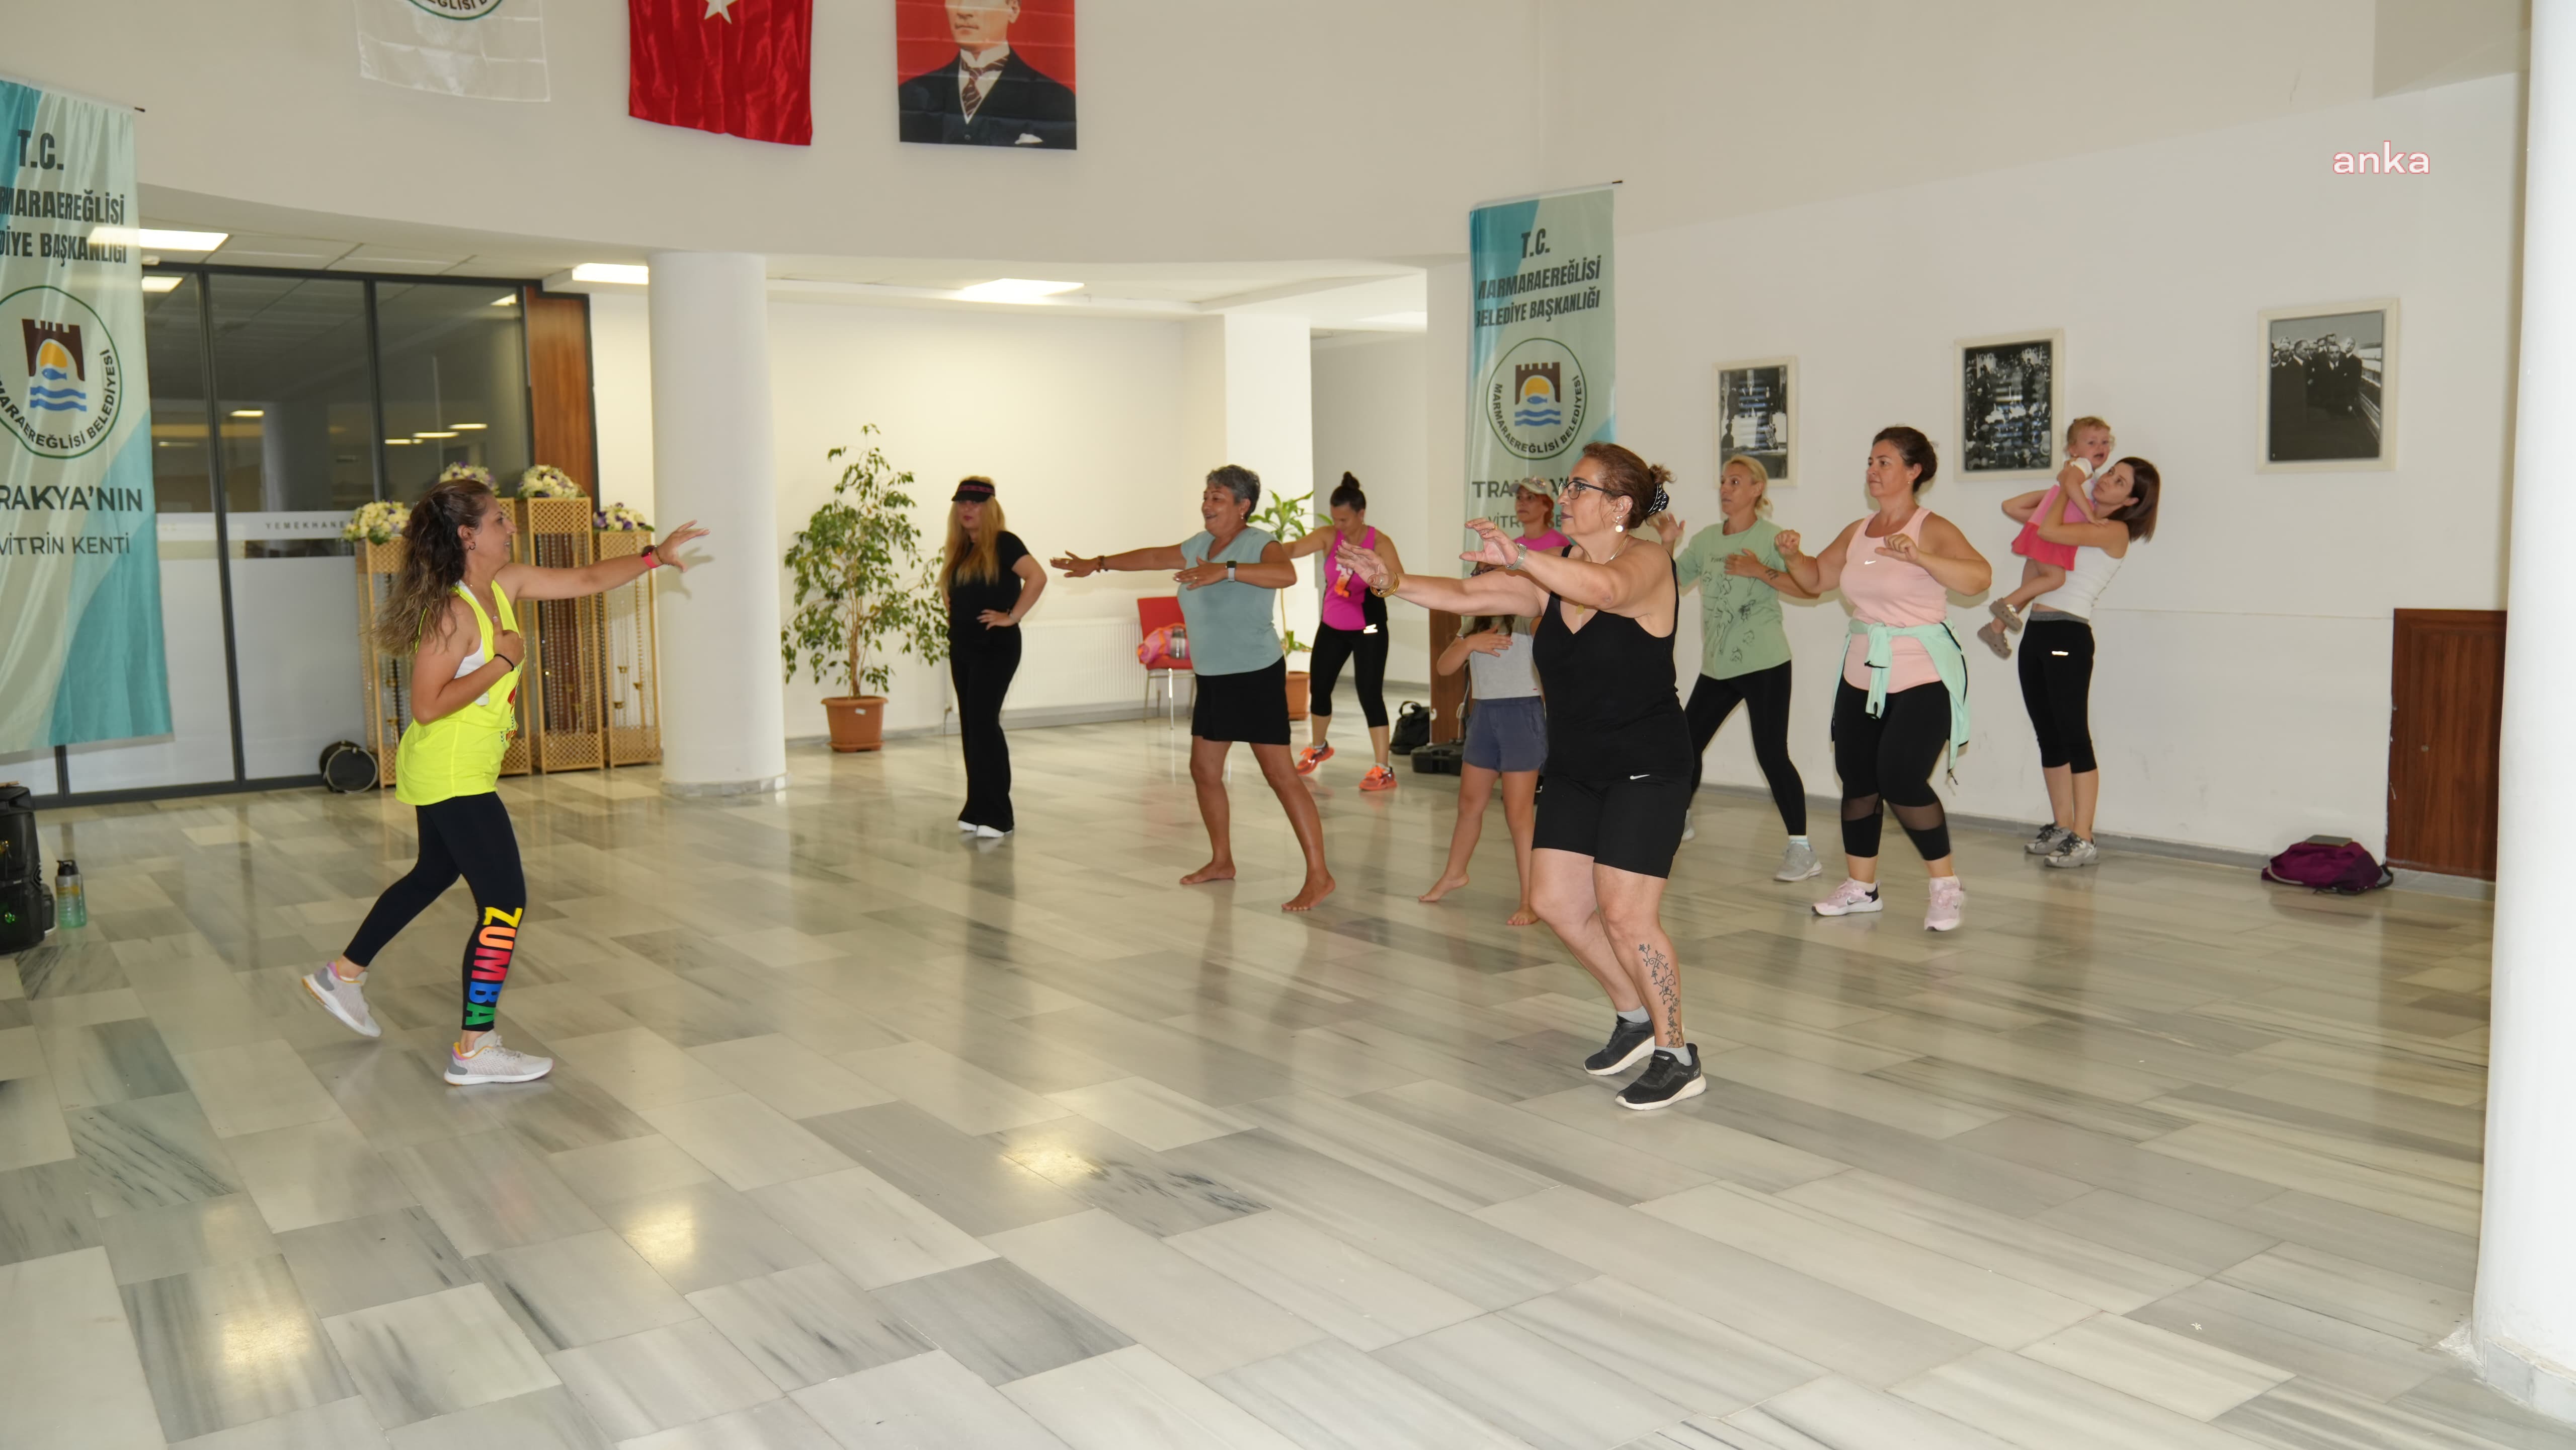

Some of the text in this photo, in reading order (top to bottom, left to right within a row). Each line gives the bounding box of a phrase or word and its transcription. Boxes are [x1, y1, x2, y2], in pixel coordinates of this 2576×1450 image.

[17, 129, 64, 170] T.C.
[1521, 228, 1551, 259] T.C.
[1529, 286, 1600, 322] BAŞKANLIĞI
[1493, 383, 1559, 453] MARMARAEREĞLİSİ
[72, 532, 130, 554] KENTİ
[266, 521, 345, 530] YEMEKHANE
[465, 906, 523, 1026] ZUMBA
